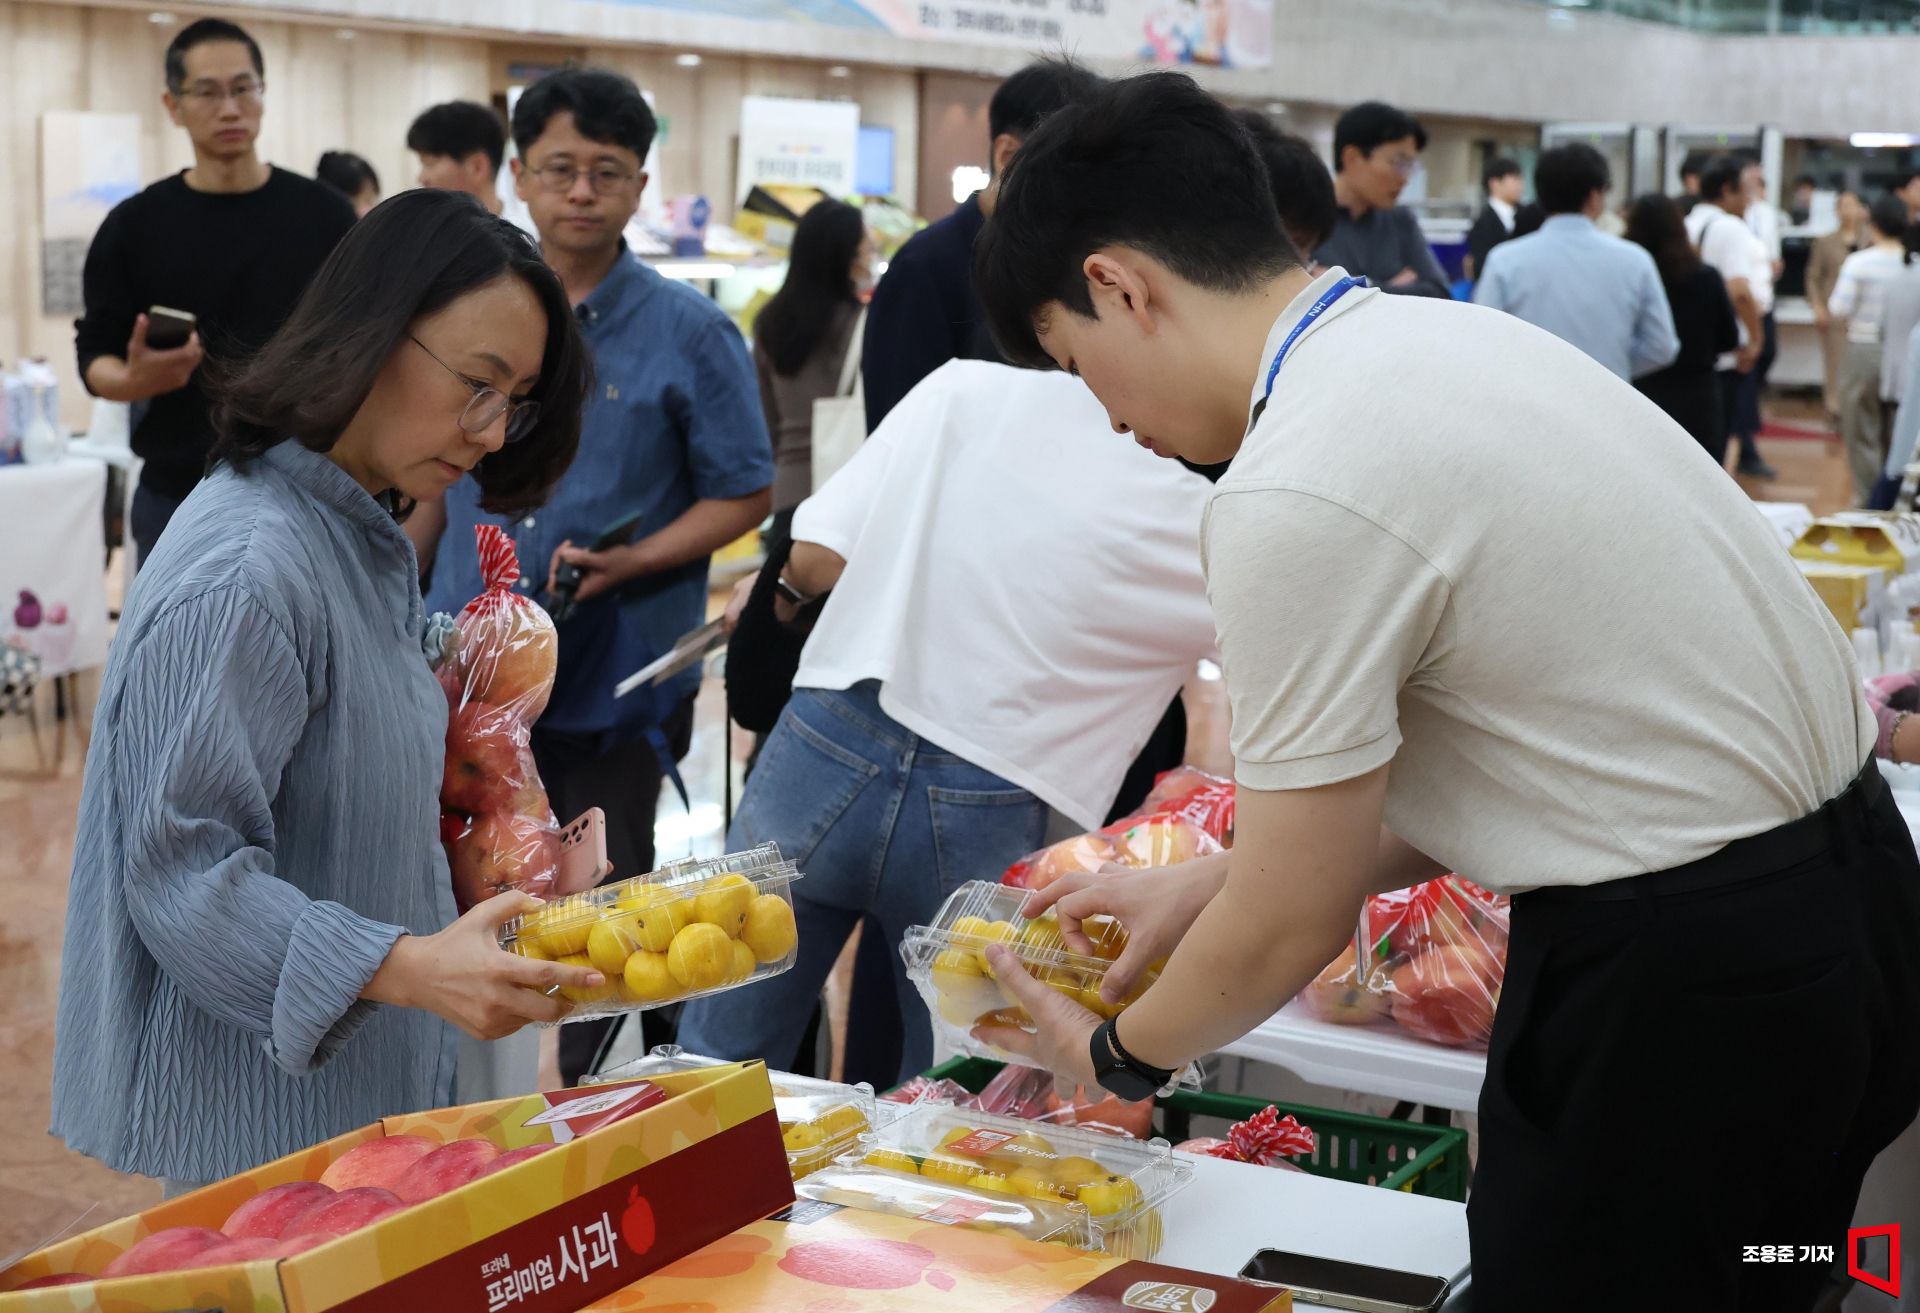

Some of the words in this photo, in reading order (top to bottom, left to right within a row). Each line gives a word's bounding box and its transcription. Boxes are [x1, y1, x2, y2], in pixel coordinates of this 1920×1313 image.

[1308, 301, 1326, 317] NH
[480, 1252, 511, 1279] 뜨라네
[485, 1254, 556, 1313] 프리미엄
[557, 1211, 619, 1283] 사과
